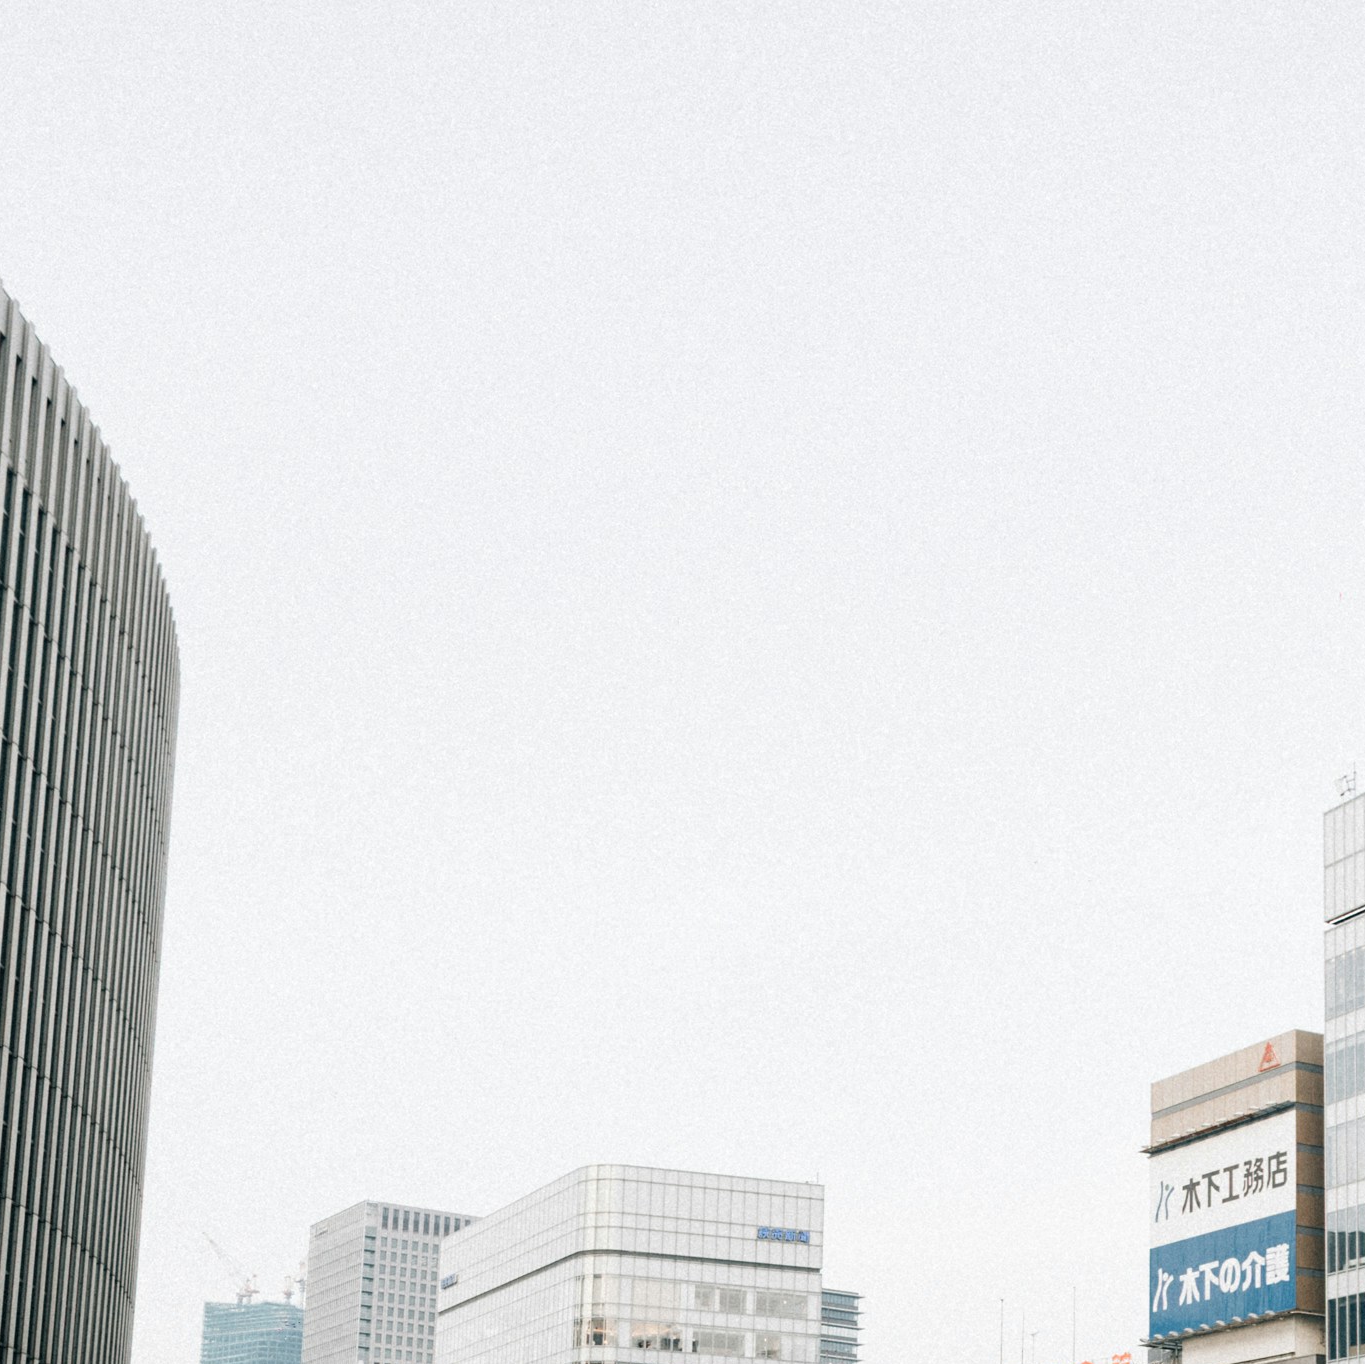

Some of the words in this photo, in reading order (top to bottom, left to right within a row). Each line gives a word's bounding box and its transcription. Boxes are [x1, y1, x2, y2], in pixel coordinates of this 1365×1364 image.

[1181, 1151, 1289, 1213] 木下工務店
[1179, 1243, 1291, 1306] 木下の介護
